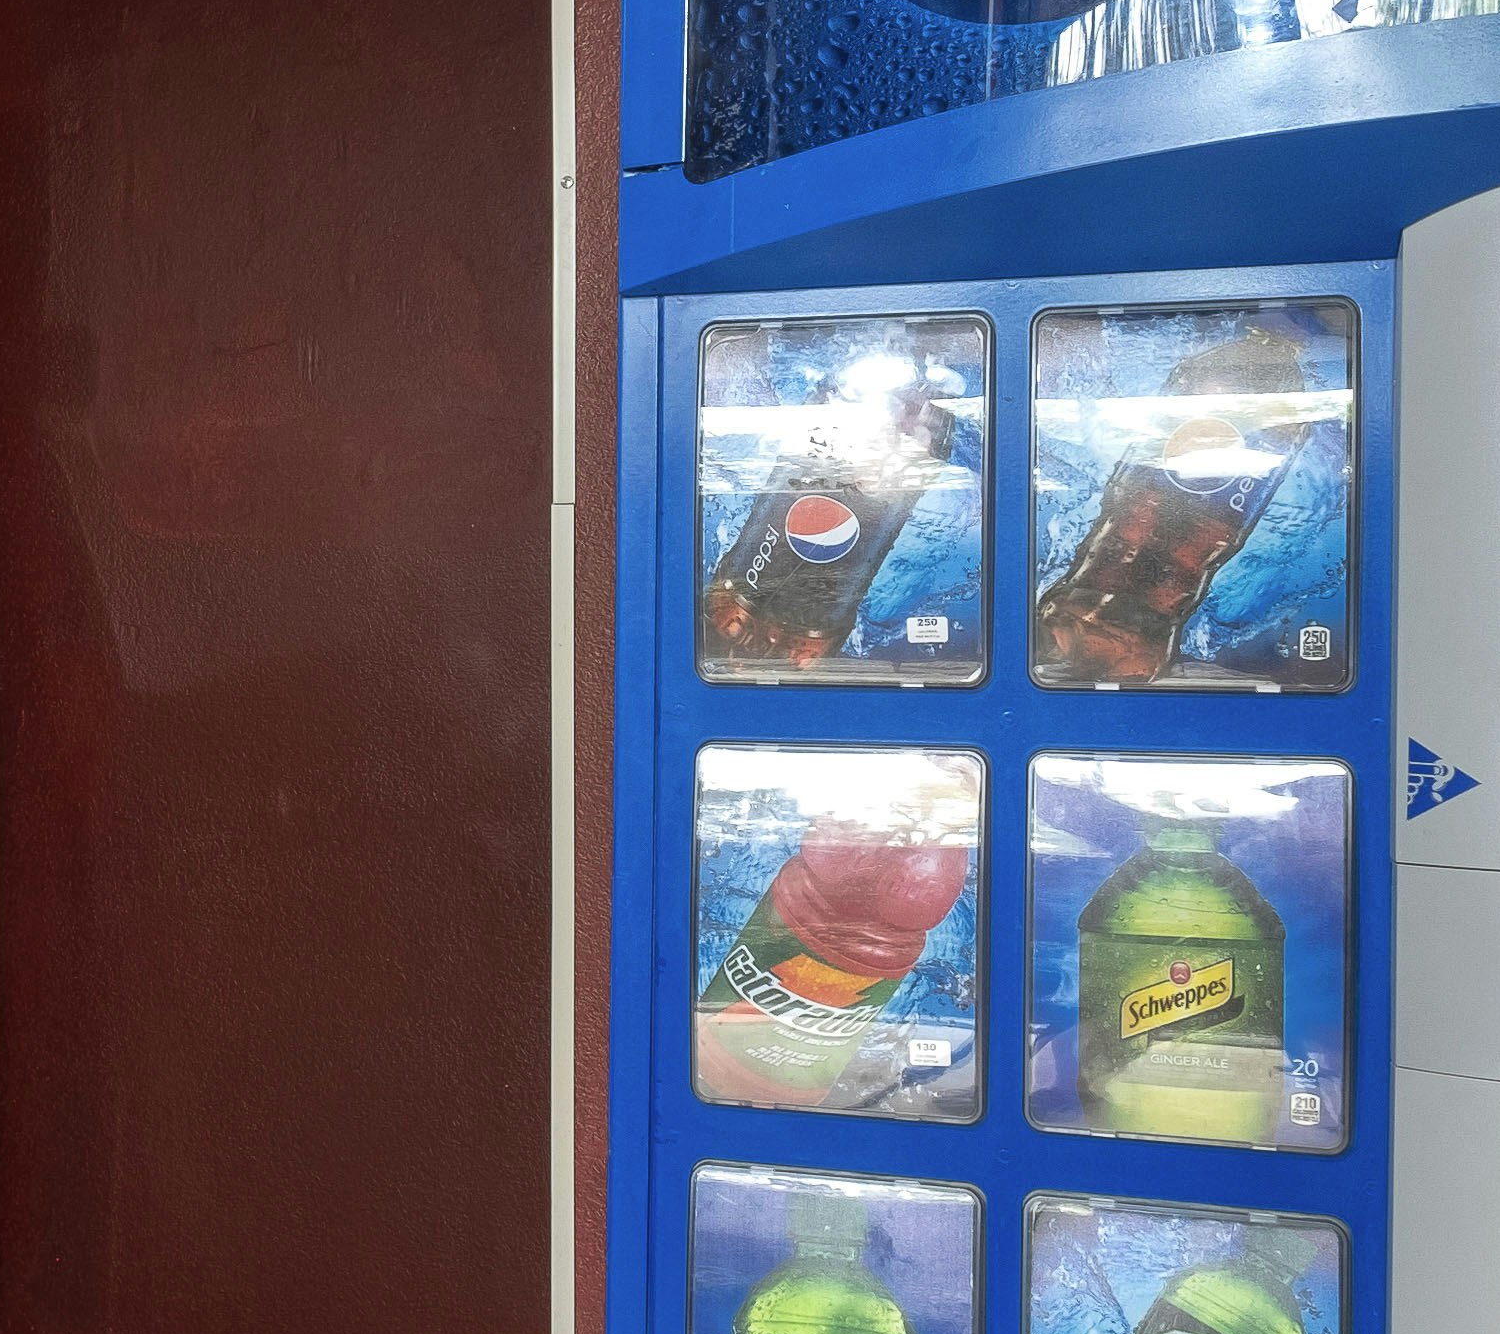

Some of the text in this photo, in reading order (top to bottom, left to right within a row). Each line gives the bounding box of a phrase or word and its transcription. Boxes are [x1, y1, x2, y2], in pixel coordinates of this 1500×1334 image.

[744, 524, 781, 590] pepsi
[915, 617, 940, 629] 250
[1302, 629, 1329, 647] 250
[723, 943, 885, 1038] Gatorade
[1126, 973, 1230, 1029] Schweppes
[1150, 1053, 1229, 1070] GINGER ALE
[1291, 1057, 1320, 1079] 20
[1294, 1096, 1319, 1112] 210
